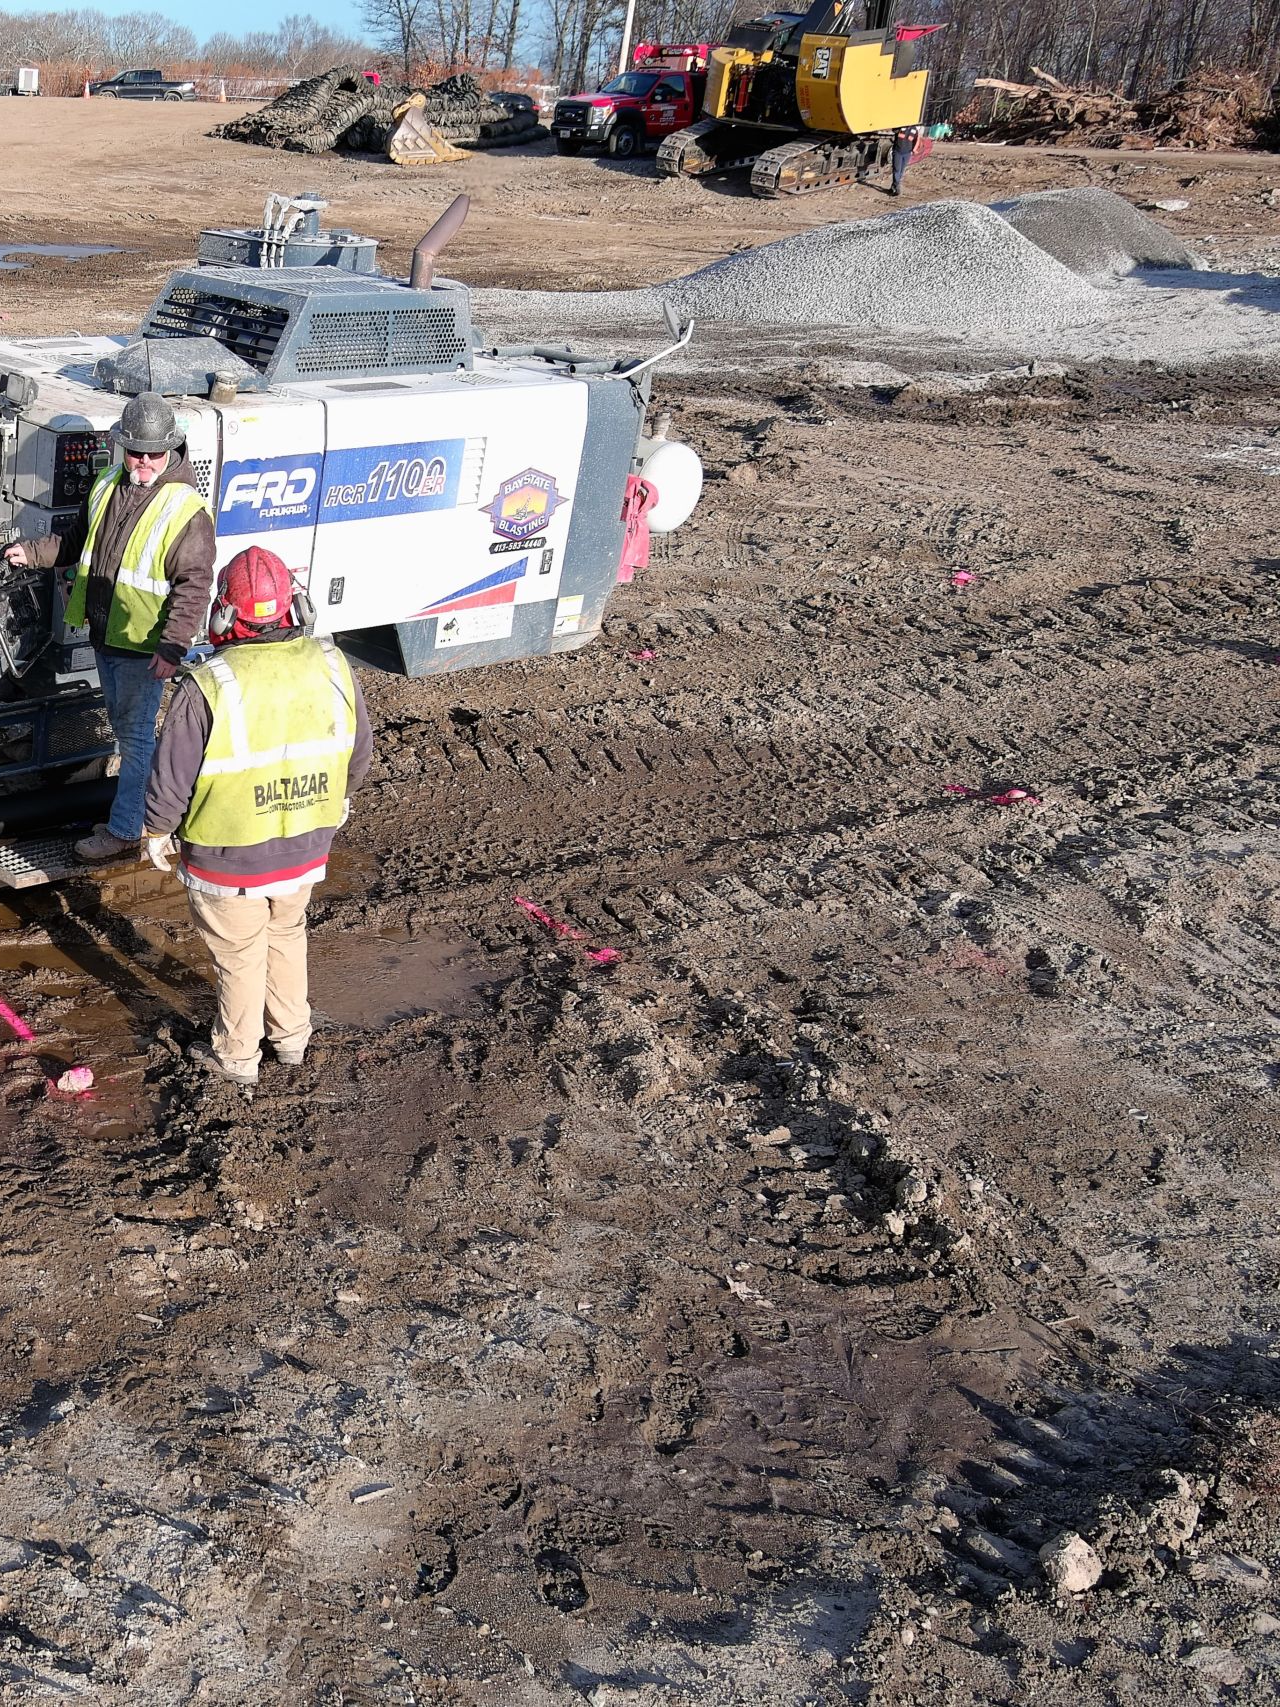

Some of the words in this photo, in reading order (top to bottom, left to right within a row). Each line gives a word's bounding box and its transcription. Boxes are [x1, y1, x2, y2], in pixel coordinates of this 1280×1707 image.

[813, 48, 830, 77] CAT
[221, 467, 316, 512] FRD
[324, 483, 366, 507] HCR
[419, 476, 445, 496] ER
[504, 474, 551, 495] BAYSTATE
[259, 504, 308, 518] FURUKAWA
[498, 515, 545, 536] BLASTING
[254, 772, 328, 807] BALTAZAR
